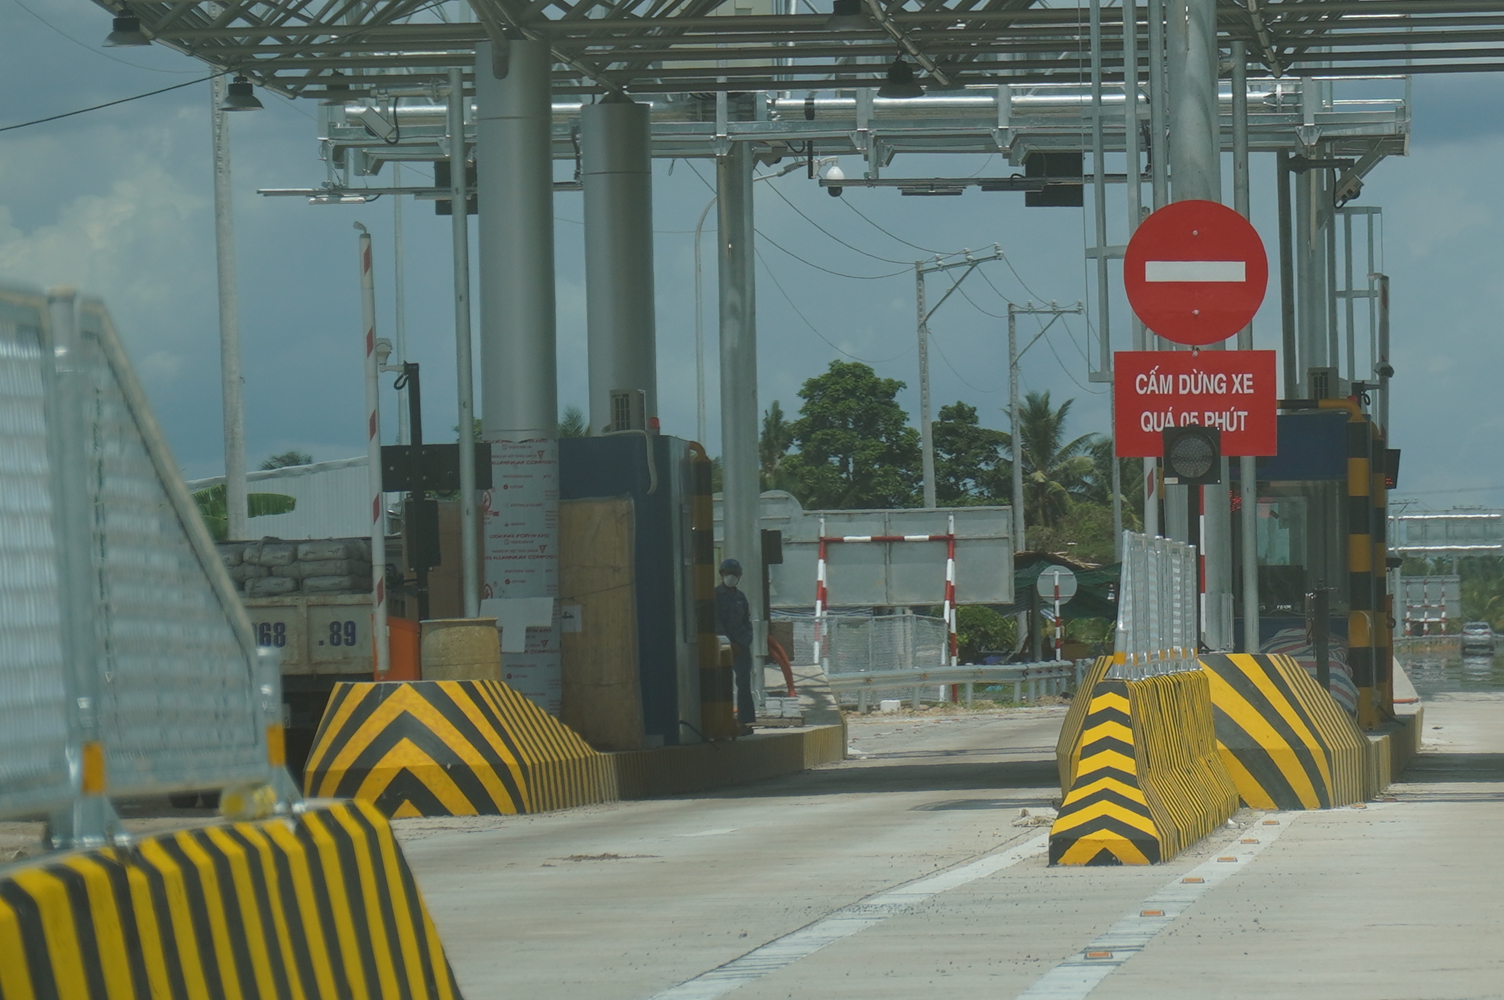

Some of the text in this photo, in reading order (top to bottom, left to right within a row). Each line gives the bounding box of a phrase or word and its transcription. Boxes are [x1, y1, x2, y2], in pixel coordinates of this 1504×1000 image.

[1135, 366, 1254, 394] CẤM DỪNG XE
[1140, 407, 1175, 432] QUÁ
[1204, 407, 1248, 432] PHÚT
